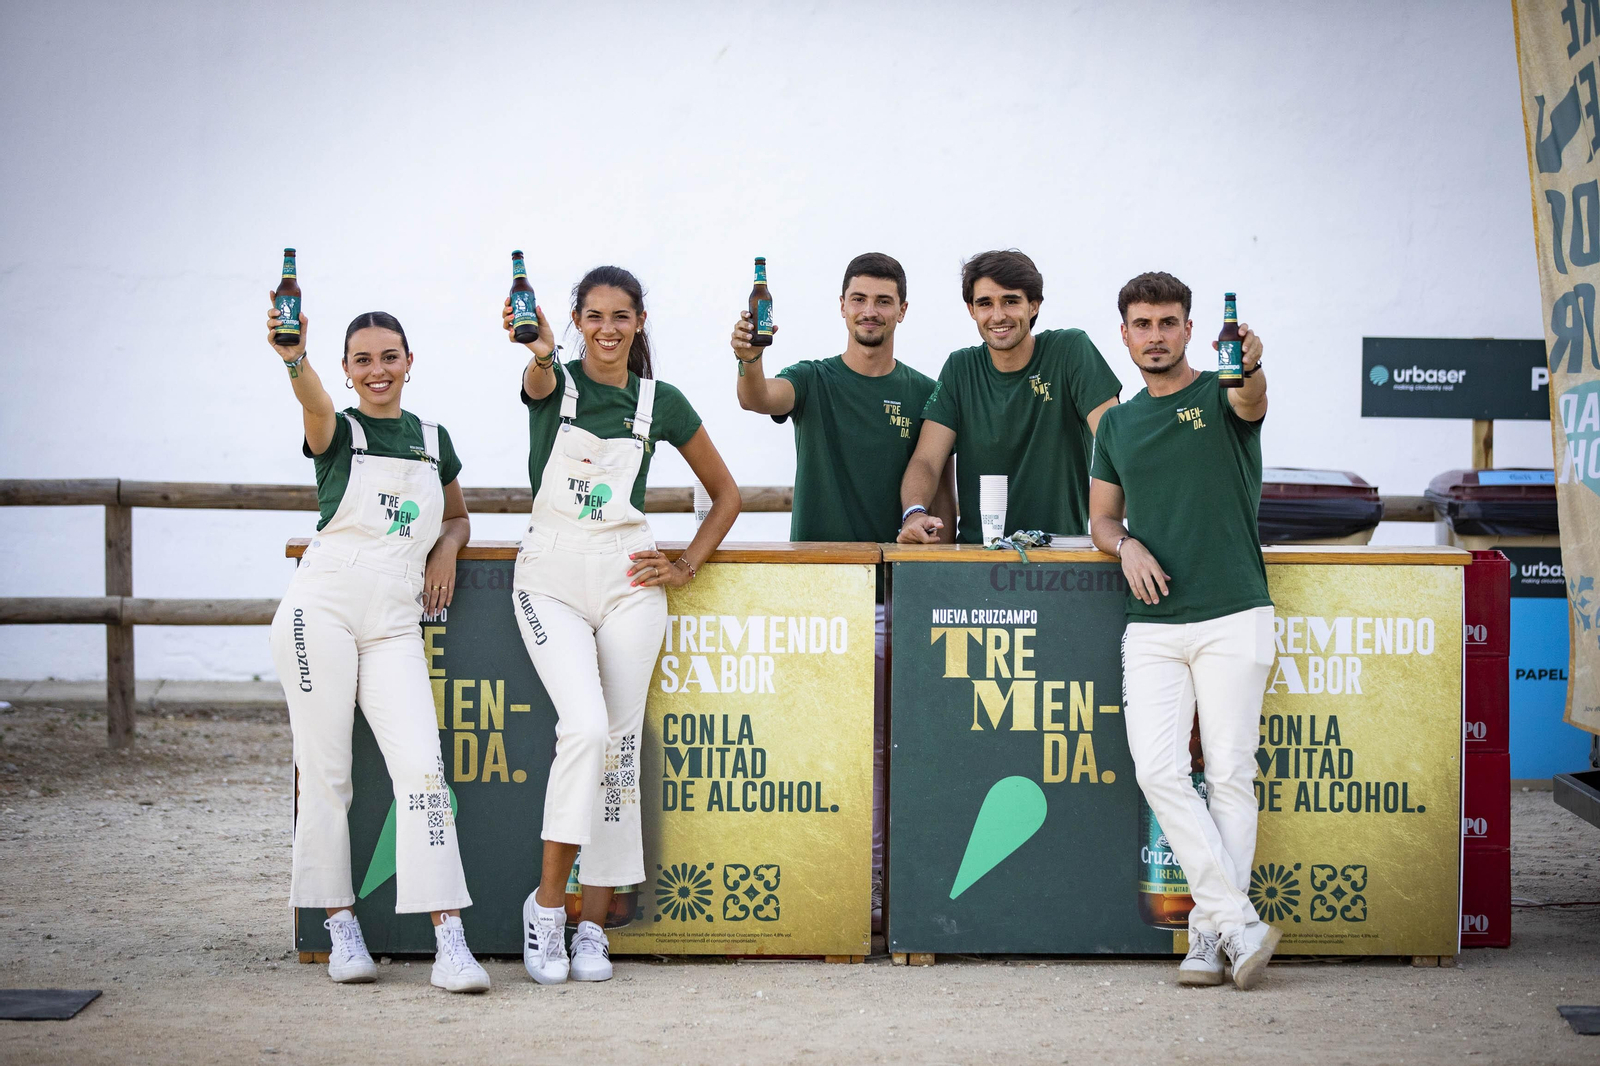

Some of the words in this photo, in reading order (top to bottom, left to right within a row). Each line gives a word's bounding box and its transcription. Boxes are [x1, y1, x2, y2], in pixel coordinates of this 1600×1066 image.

[1393, 365, 1466, 383] urbaser
[883, 404, 901, 415] TRE
[378, 493, 400, 508] TRE
[567, 477, 591, 493] TRE
[574, 493, 608, 508] MEN-
[384, 508, 416, 524] MEN-
[990, 563, 1126, 592] Cruzcam
[932, 608, 969, 625] NUEVA
[971, 609, 1038, 625] CRUZCAMPO
[293, 608, 313, 692] Cruzcampo
[663, 615, 849, 655] TREMENDO
[1273, 616, 1435, 656] REMENDO
[930, 627, 1037, 678] TRE
[661, 655, 776, 694] SABOR
[1266, 656, 1364, 696] ABOR
[1515, 668, 1568, 681] PAPEL
[970, 680, 1120, 731] MEN-
[663, 713, 715, 746] CON
[723, 714, 755, 746] LA
[1310, 714, 1341, 746] LA
[453, 732, 528, 783] DA.
[662, 747, 767, 779] MITAD
[1043, 732, 1117, 784] DA.
[1256, 747, 1354, 780] MITAD
[662, 780, 695, 813] DE
[706, 780, 840, 813] ALCOHOL.
[1254, 781, 1282, 813] DE
[1294, 781, 1427, 814] ALCOHOL.
